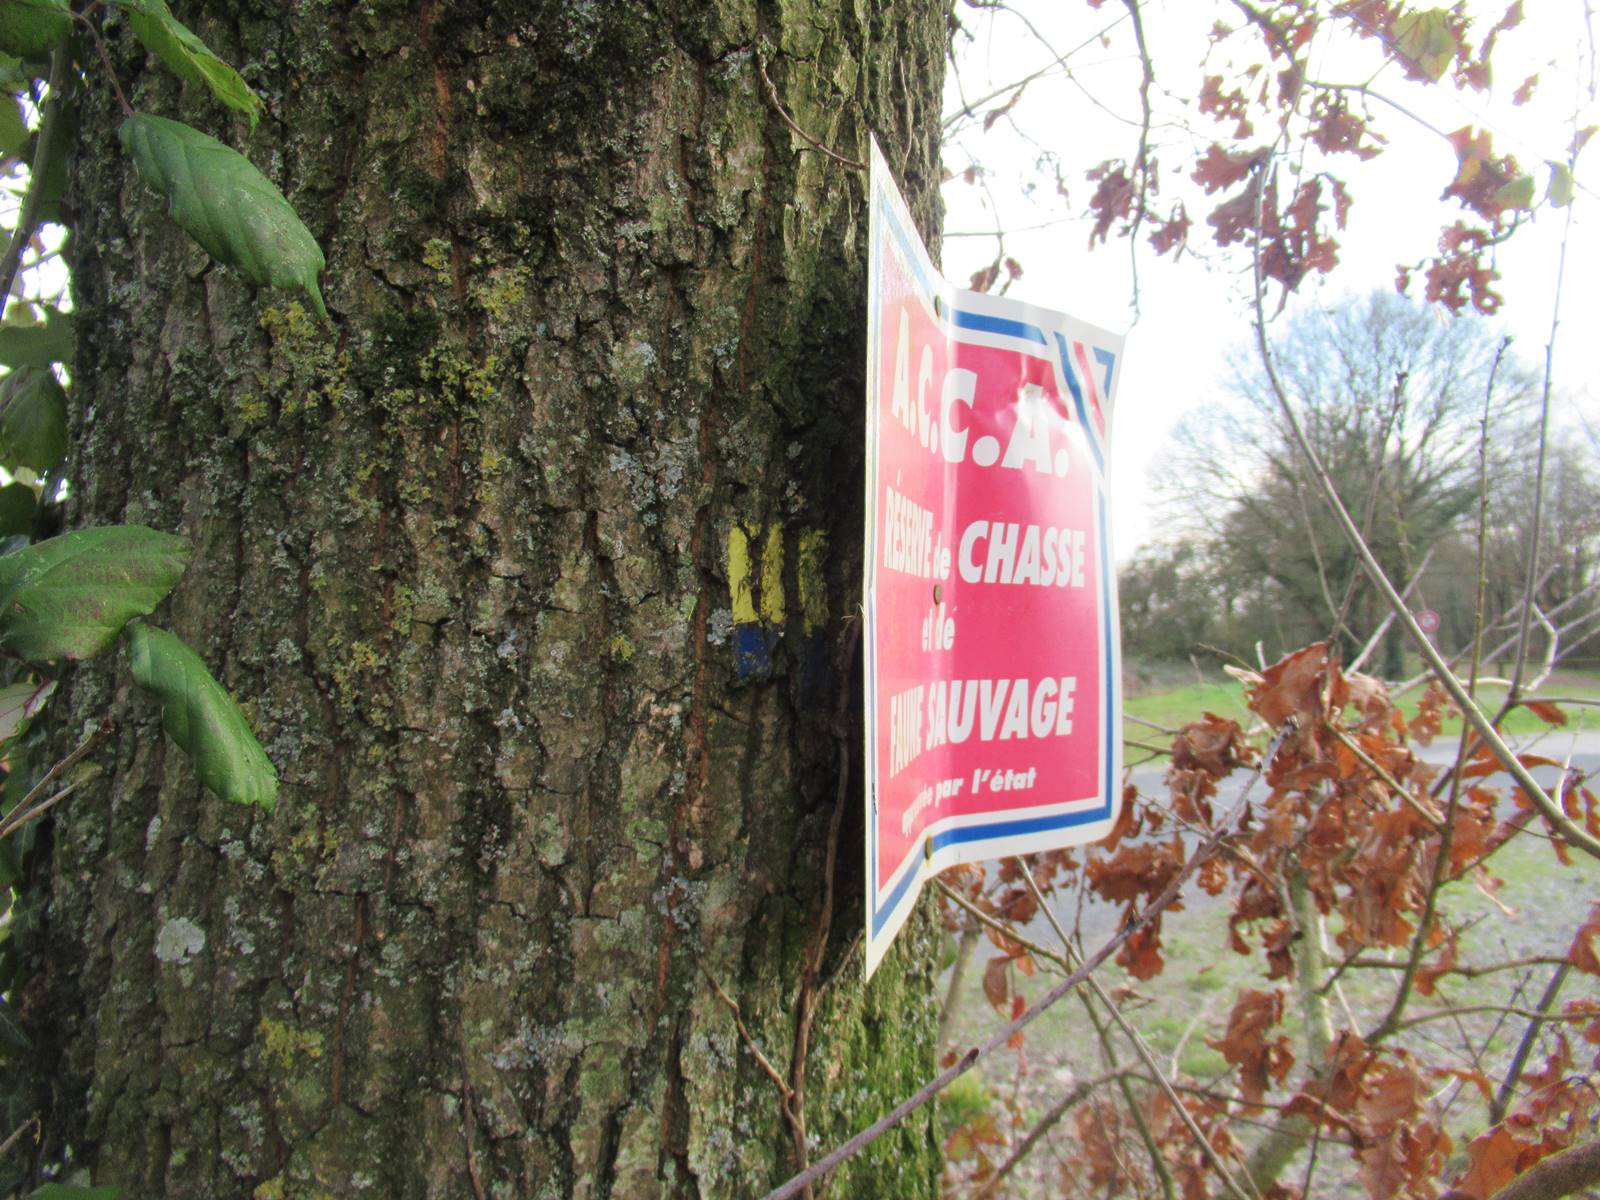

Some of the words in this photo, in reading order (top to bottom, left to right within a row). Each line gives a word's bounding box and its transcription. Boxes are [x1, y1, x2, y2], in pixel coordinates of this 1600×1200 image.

[892, 306, 1069, 478] A.C.C.A.
[884, 469, 933, 579] RÉSERVE
[933, 530, 951, 580] de
[958, 520, 1085, 588] CHASSE
[926, 676, 1077, 750] SAUVAGE
[935, 778, 963, 808] par
[971, 767, 1036, 794] l'état
